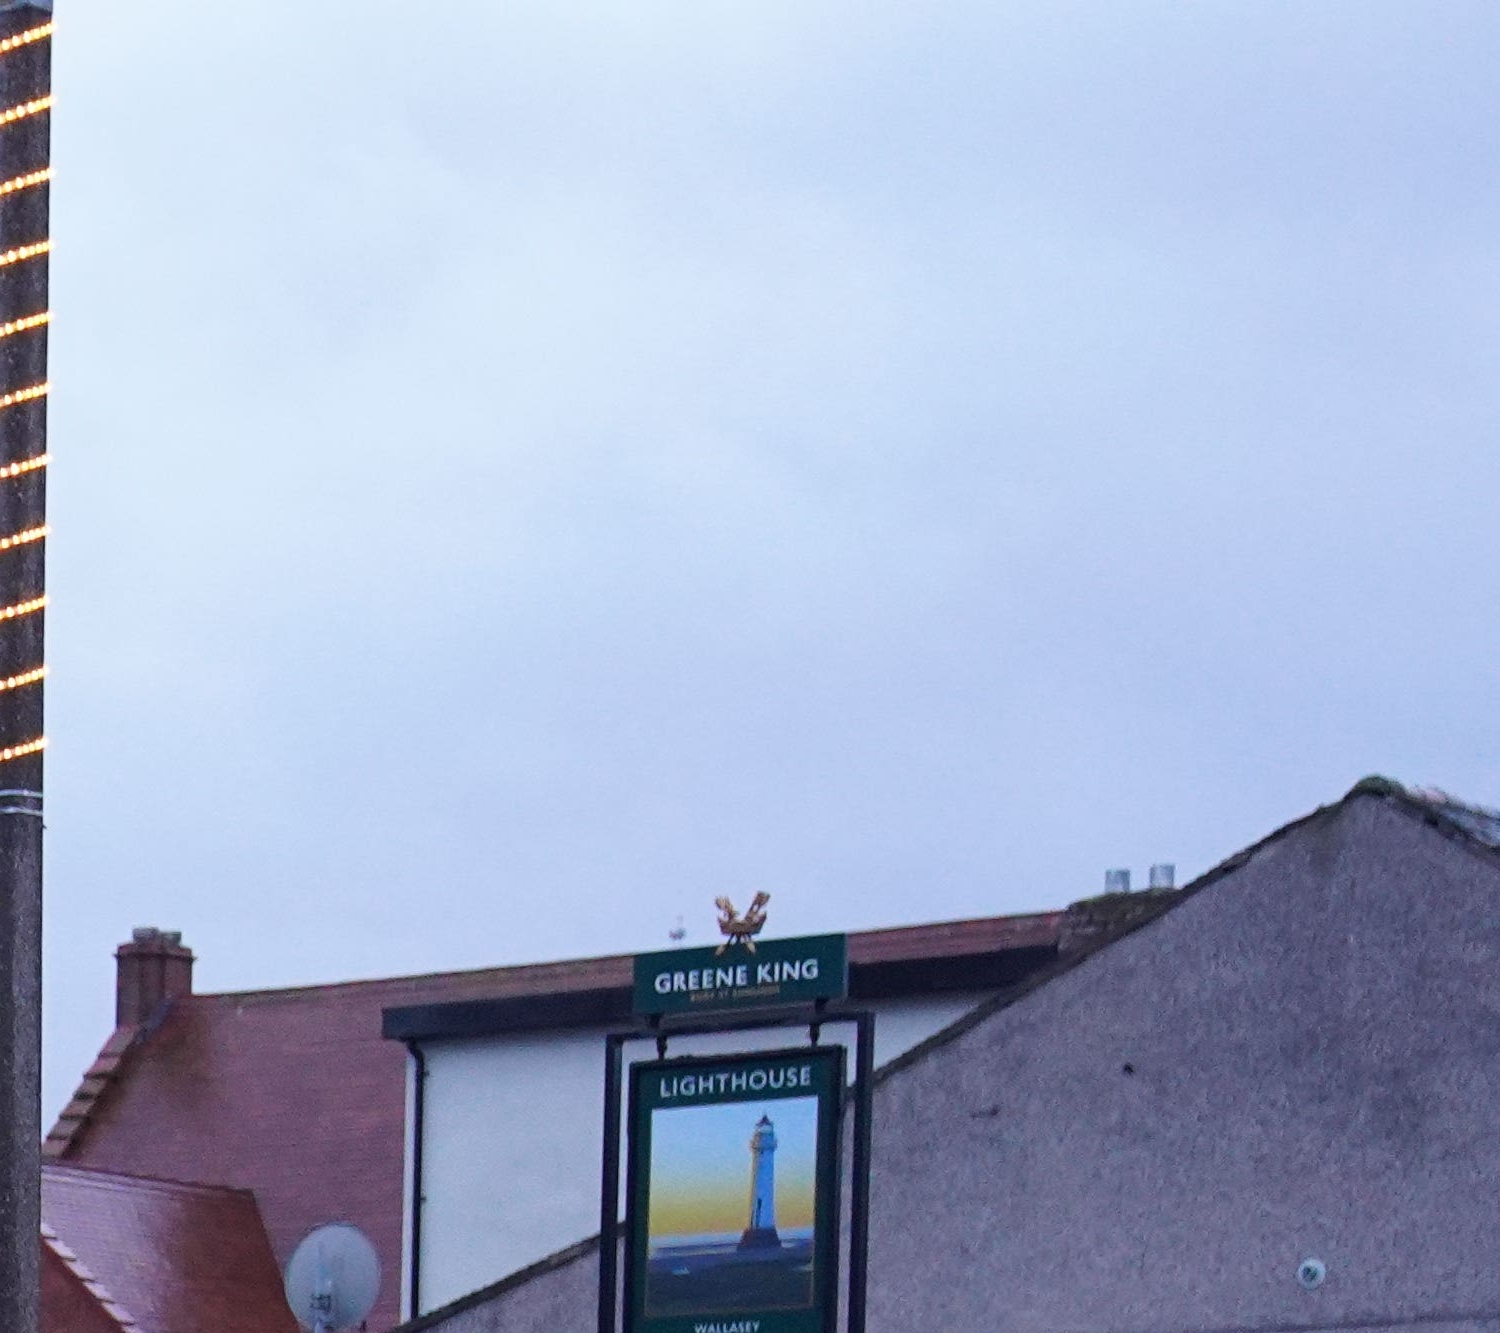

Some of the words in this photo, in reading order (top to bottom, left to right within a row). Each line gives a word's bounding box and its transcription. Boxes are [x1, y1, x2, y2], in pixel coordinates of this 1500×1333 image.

[654, 964, 748, 994] GREENE
[756, 958, 819, 984] KING
[659, 1065, 812, 1099] LIGHTHOUSE
